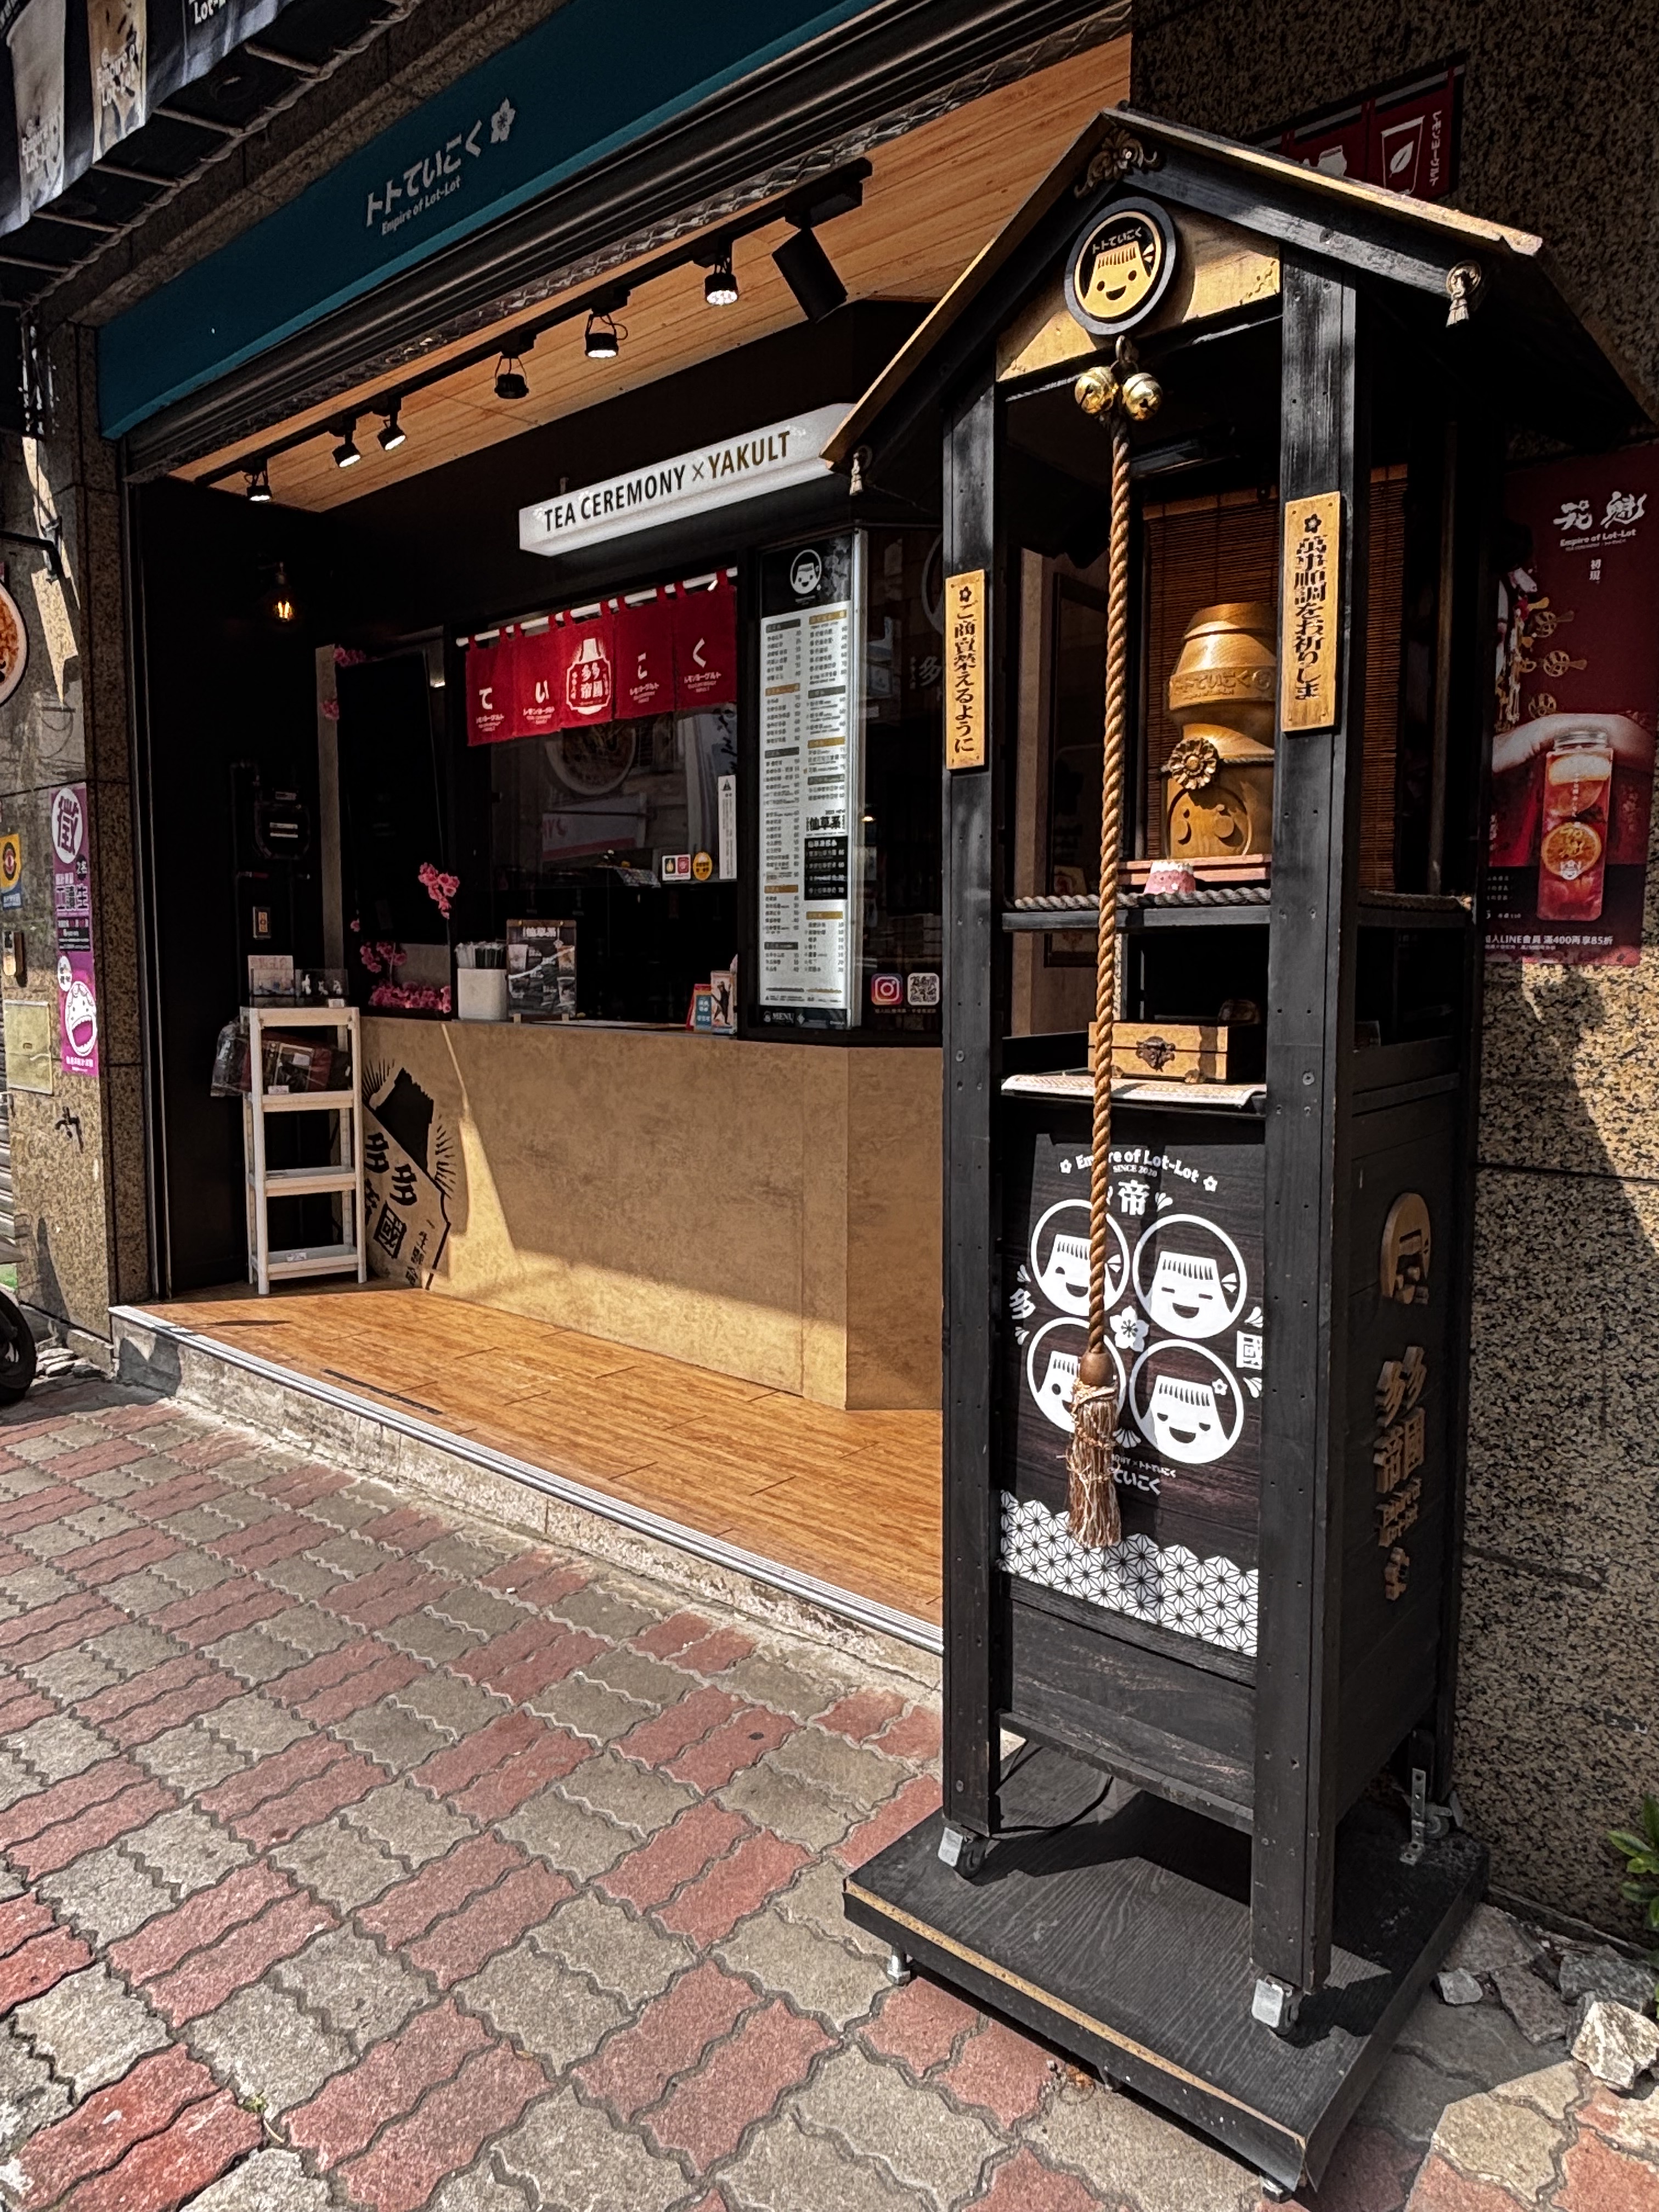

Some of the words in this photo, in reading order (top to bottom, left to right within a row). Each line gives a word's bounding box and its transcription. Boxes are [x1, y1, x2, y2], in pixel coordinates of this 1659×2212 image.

[381, 208, 412, 236] Empire
[413, 199, 425, 216] of
[425, 175, 461, 208] Lot-Lot
[544, 501, 576, 532] TEA
[580, 464, 685, 520] CEREMONY
[707, 431, 791, 479] YAKULT
[1590, 533, 1601, 542] of
[535, 680, 550, 703] い
[693, 637, 706, 668] く
[1076, 1150, 1122, 1169] Emre
[1124, 1149, 1142, 1163] of
[1144, 1149, 1199, 1183] Lot-Lot
[1113, 1164, 1137, 1173] SINCE
[1118, 1180, 1149, 1216] 帝
[1113, 1469, 1161, 1495] ていこく
